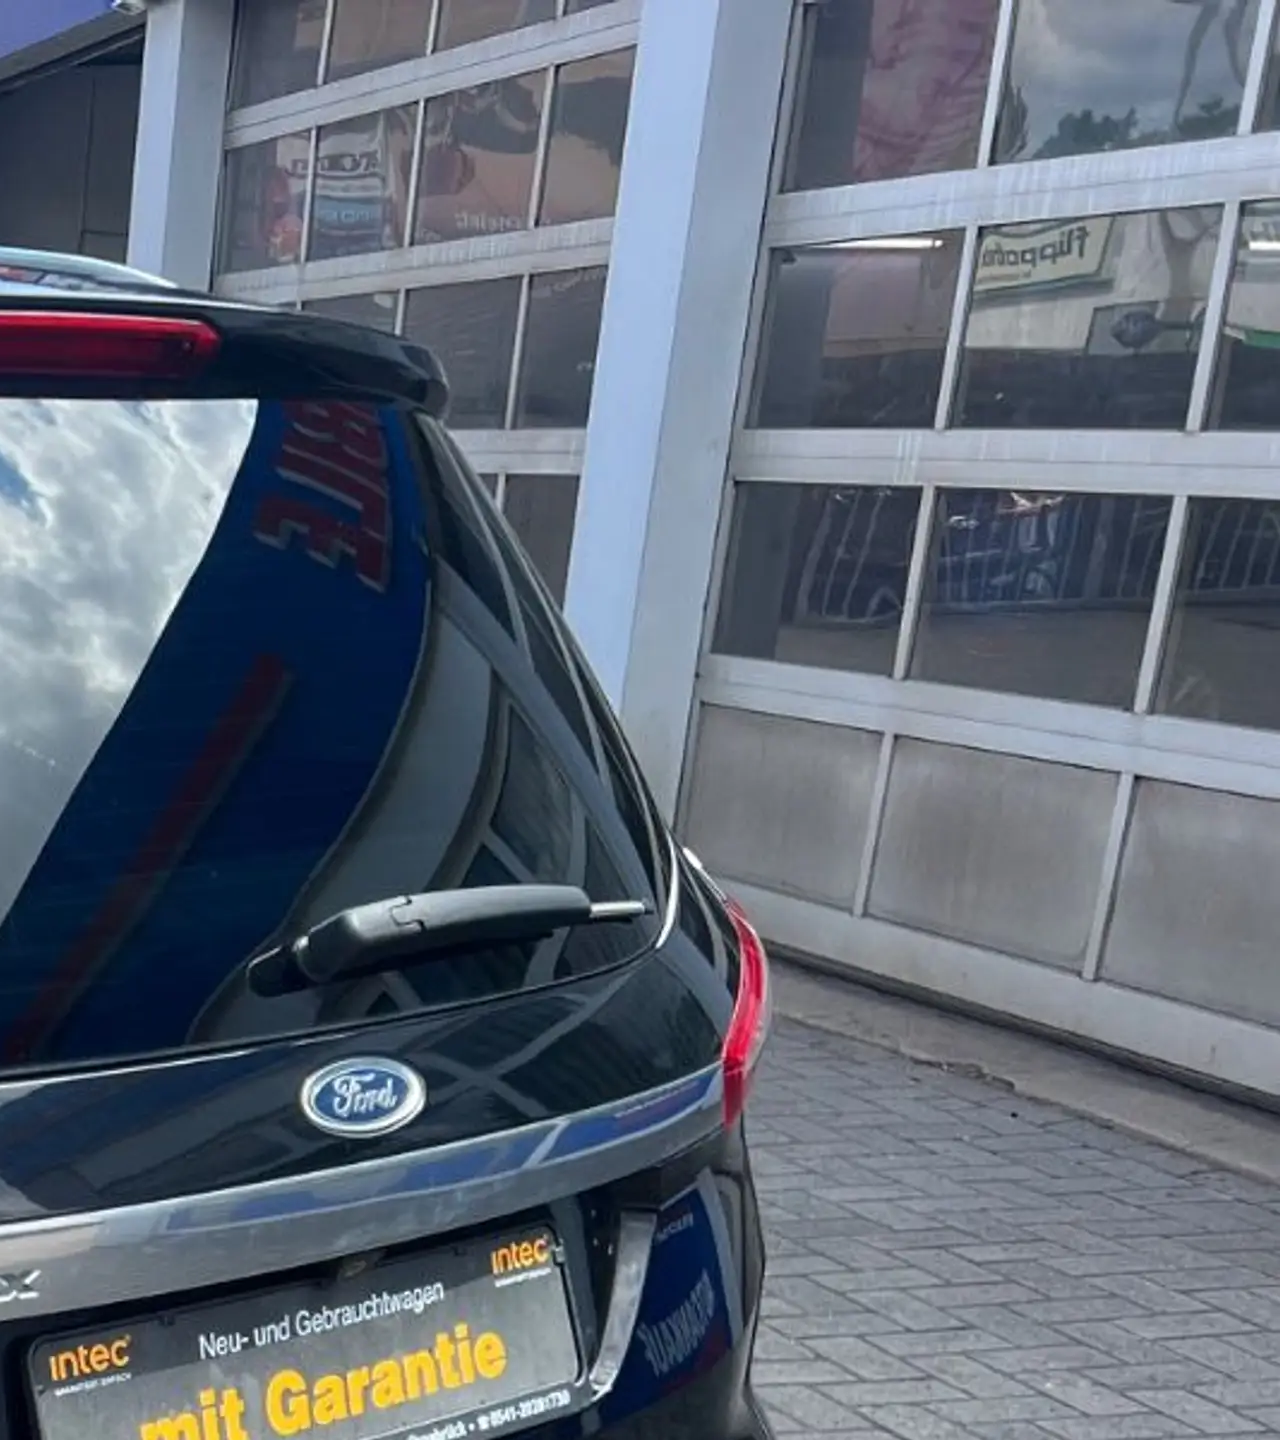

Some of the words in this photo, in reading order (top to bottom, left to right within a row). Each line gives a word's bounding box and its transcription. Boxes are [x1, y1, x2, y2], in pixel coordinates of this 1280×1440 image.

[331, 1072, 399, 1118] Ford
[198, 1332, 249, 1361] Neu-
[253, 1314, 290, 1347] und
[295, 1281, 446, 1337] Gebrauchtwagen
[266, 1322, 509, 1437] Garantie
